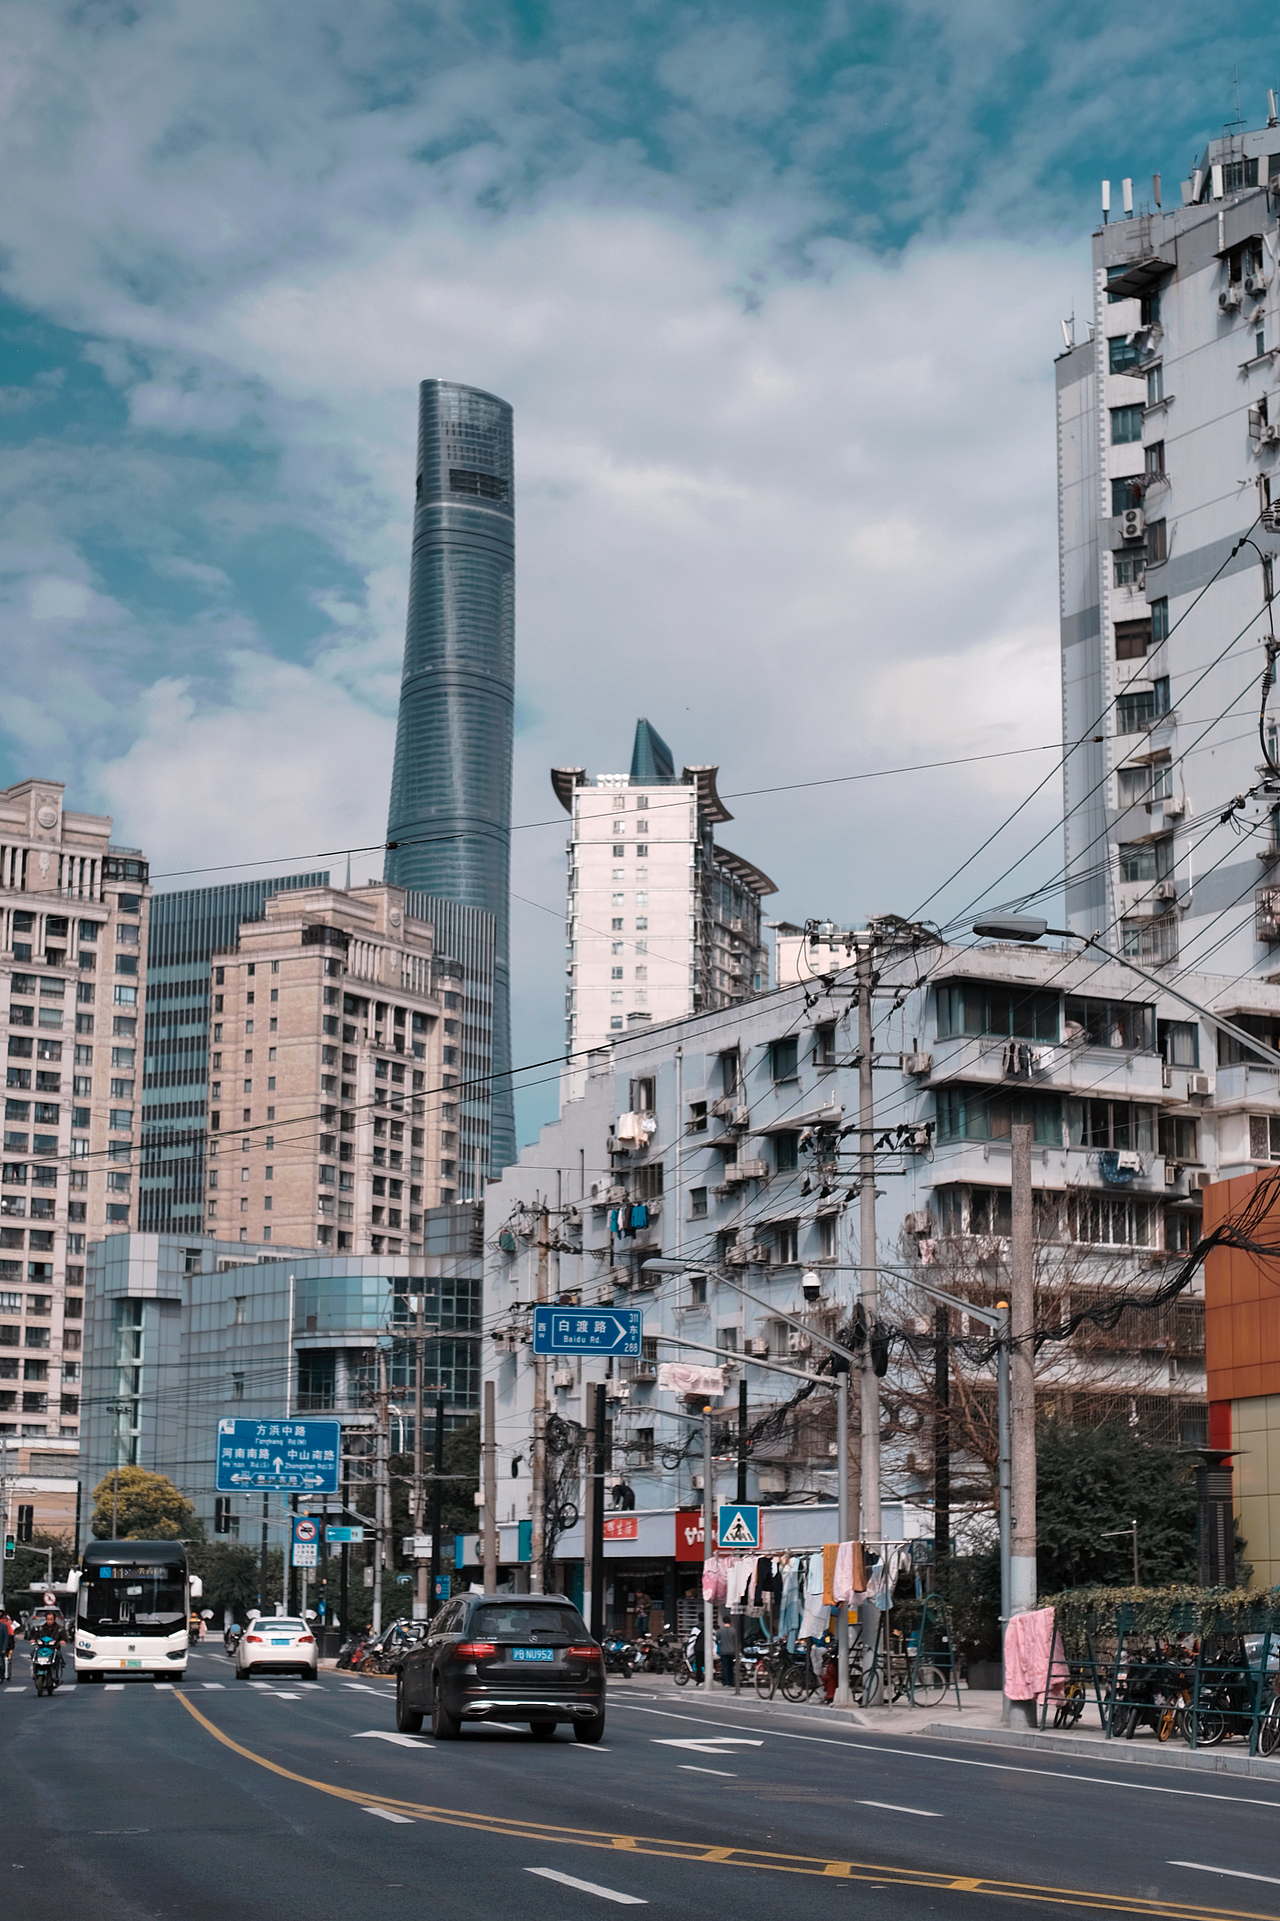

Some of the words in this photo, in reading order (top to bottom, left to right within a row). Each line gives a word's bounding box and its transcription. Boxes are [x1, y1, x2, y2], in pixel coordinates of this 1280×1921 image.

[628, 1313, 639, 1323] 311
[537, 1322, 547, 1332] 西
[558, 1319, 607, 1333] 白渡路
[629, 1325, 638, 1334] 东
[563, 1335, 586, 1343] Baidu
[590, 1336, 602, 1344] Rd.
[624, 1343, 638, 1352] 288
[256, 1425, 306, 1437] 方浜中路
[221, 1447, 270, 1459] 河南南路
[287, 1449, 335, 1461] 中山南路
